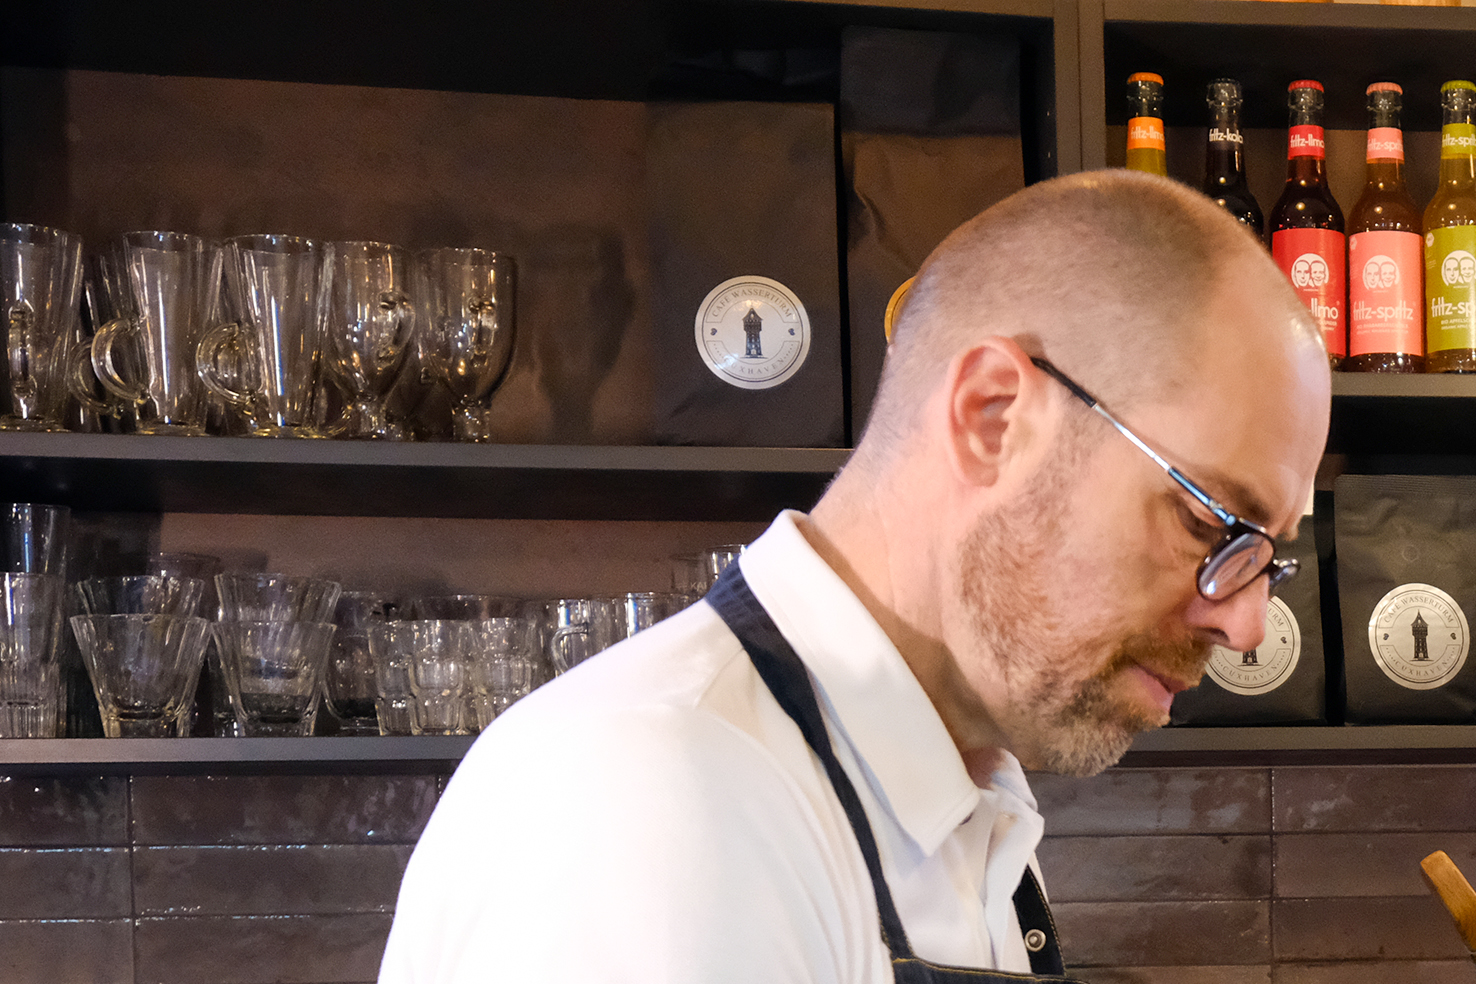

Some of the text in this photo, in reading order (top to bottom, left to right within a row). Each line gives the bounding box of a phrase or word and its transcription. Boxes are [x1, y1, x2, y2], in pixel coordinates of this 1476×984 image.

[731, 288, 792, 317] WASSERTURM
[1353, 300, 1413, 322] fritz-spritz
[1401, 595, 1454, 623] WASSERTURM
[1222, 665, 1278, 681] CUXHAVEN
